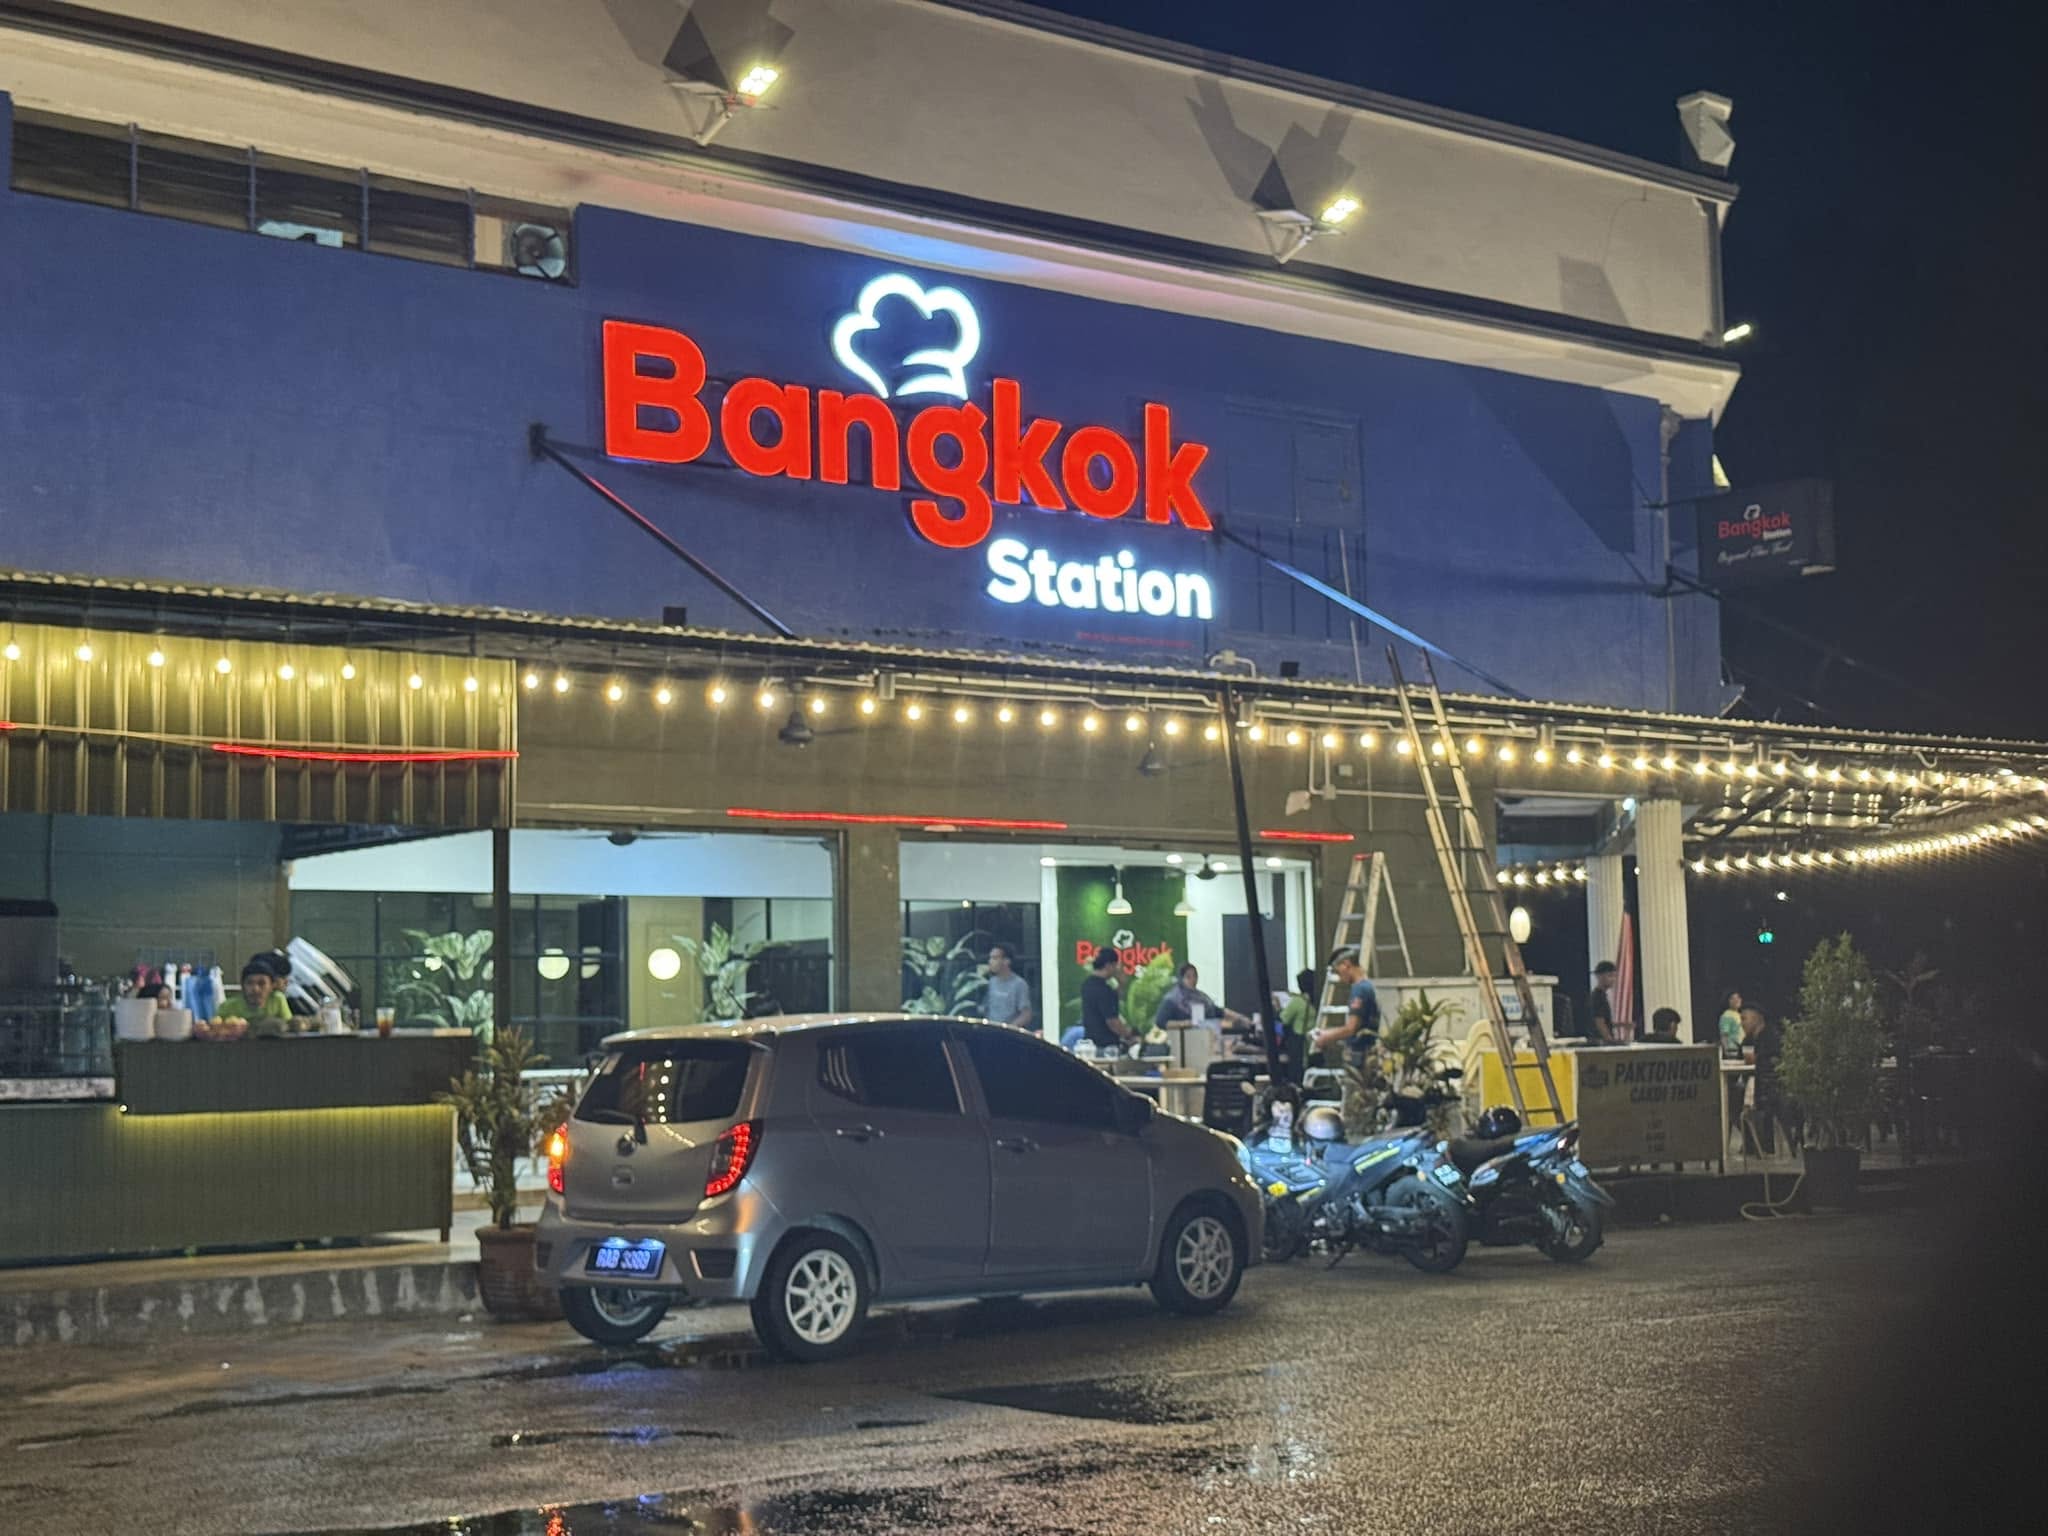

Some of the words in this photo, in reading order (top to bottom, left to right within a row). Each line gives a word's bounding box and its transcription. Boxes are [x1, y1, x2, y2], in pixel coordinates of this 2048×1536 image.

[602, 319, 1213, 548] Bangkok
[1717, 511, 1791, 539] Bangkok
[986, 539, 1213, 619] Station
